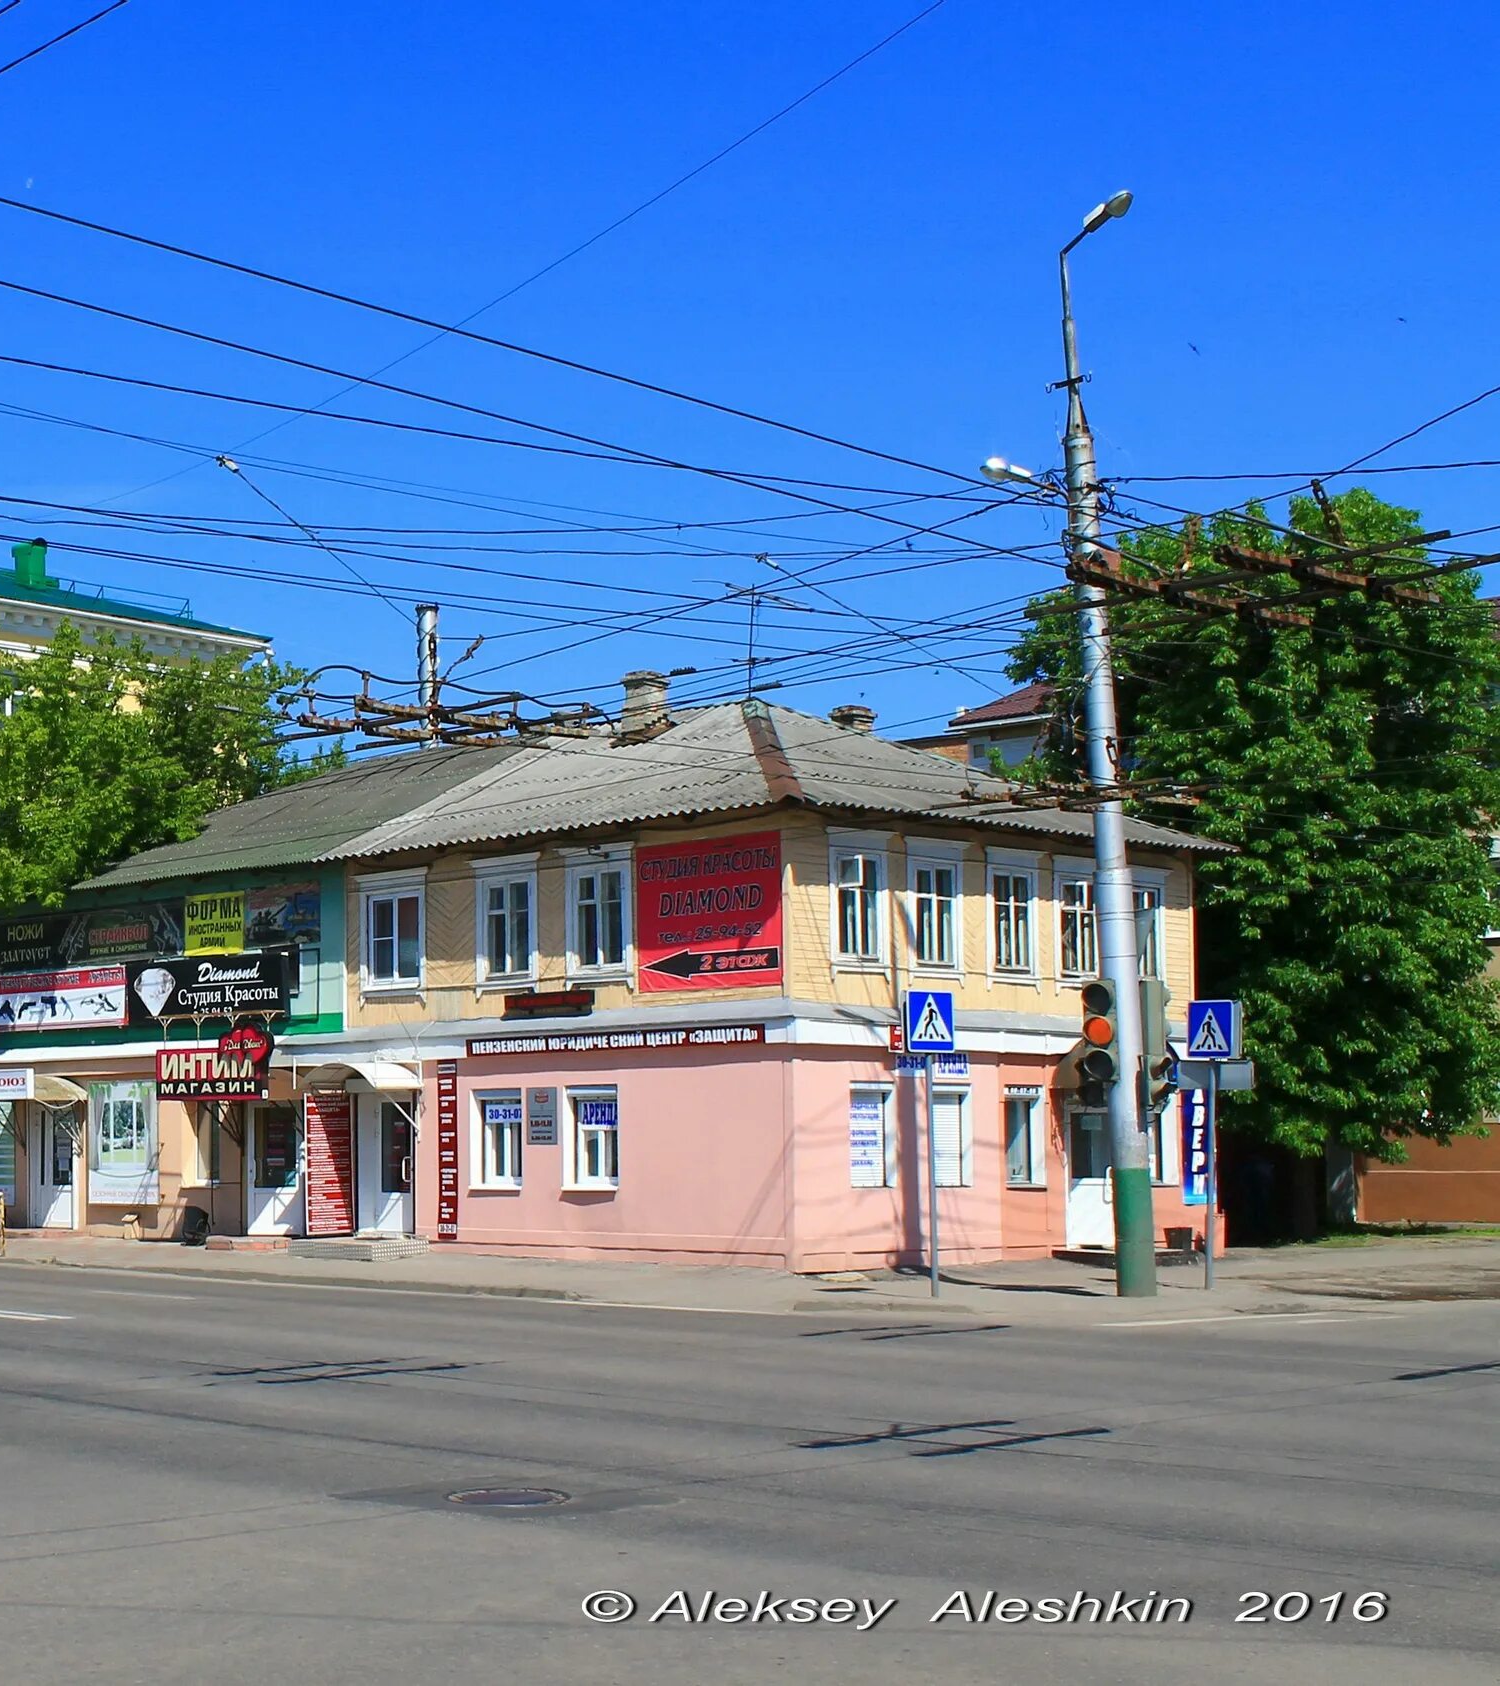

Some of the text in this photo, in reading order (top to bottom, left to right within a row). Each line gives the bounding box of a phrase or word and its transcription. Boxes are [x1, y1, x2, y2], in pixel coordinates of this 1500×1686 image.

[640, 845, 777, 882] СТУДИЯ КРАСОТЫ
[658, 883, 763, 918] DIAMOND
[7, 923, 44, 942] НОЖИ
[188, 920, 242, 936] ИНОСТРАННЫХ
[200, 936, 226, 948] АРМИЙ
[1, 946, 51, 965] ЗЛАТОУСТ
[700, 953, 769, 971] 2 этаж
[198, 961, 260, 983] Diamond
[178, 984, 278, 1010] Студия Красоты
[472, 1038, 546, 1055] ПЕНЗЕНСКИЙ
[646, 1030, 687, 1048] ЦЕНТР
[689, 1027, 758, 1045] «ЗАЩИТА»
[161, 1052, 254, 1080] ИНТИМ
[161, 1082, 255, 1094] МАГАЗИН
